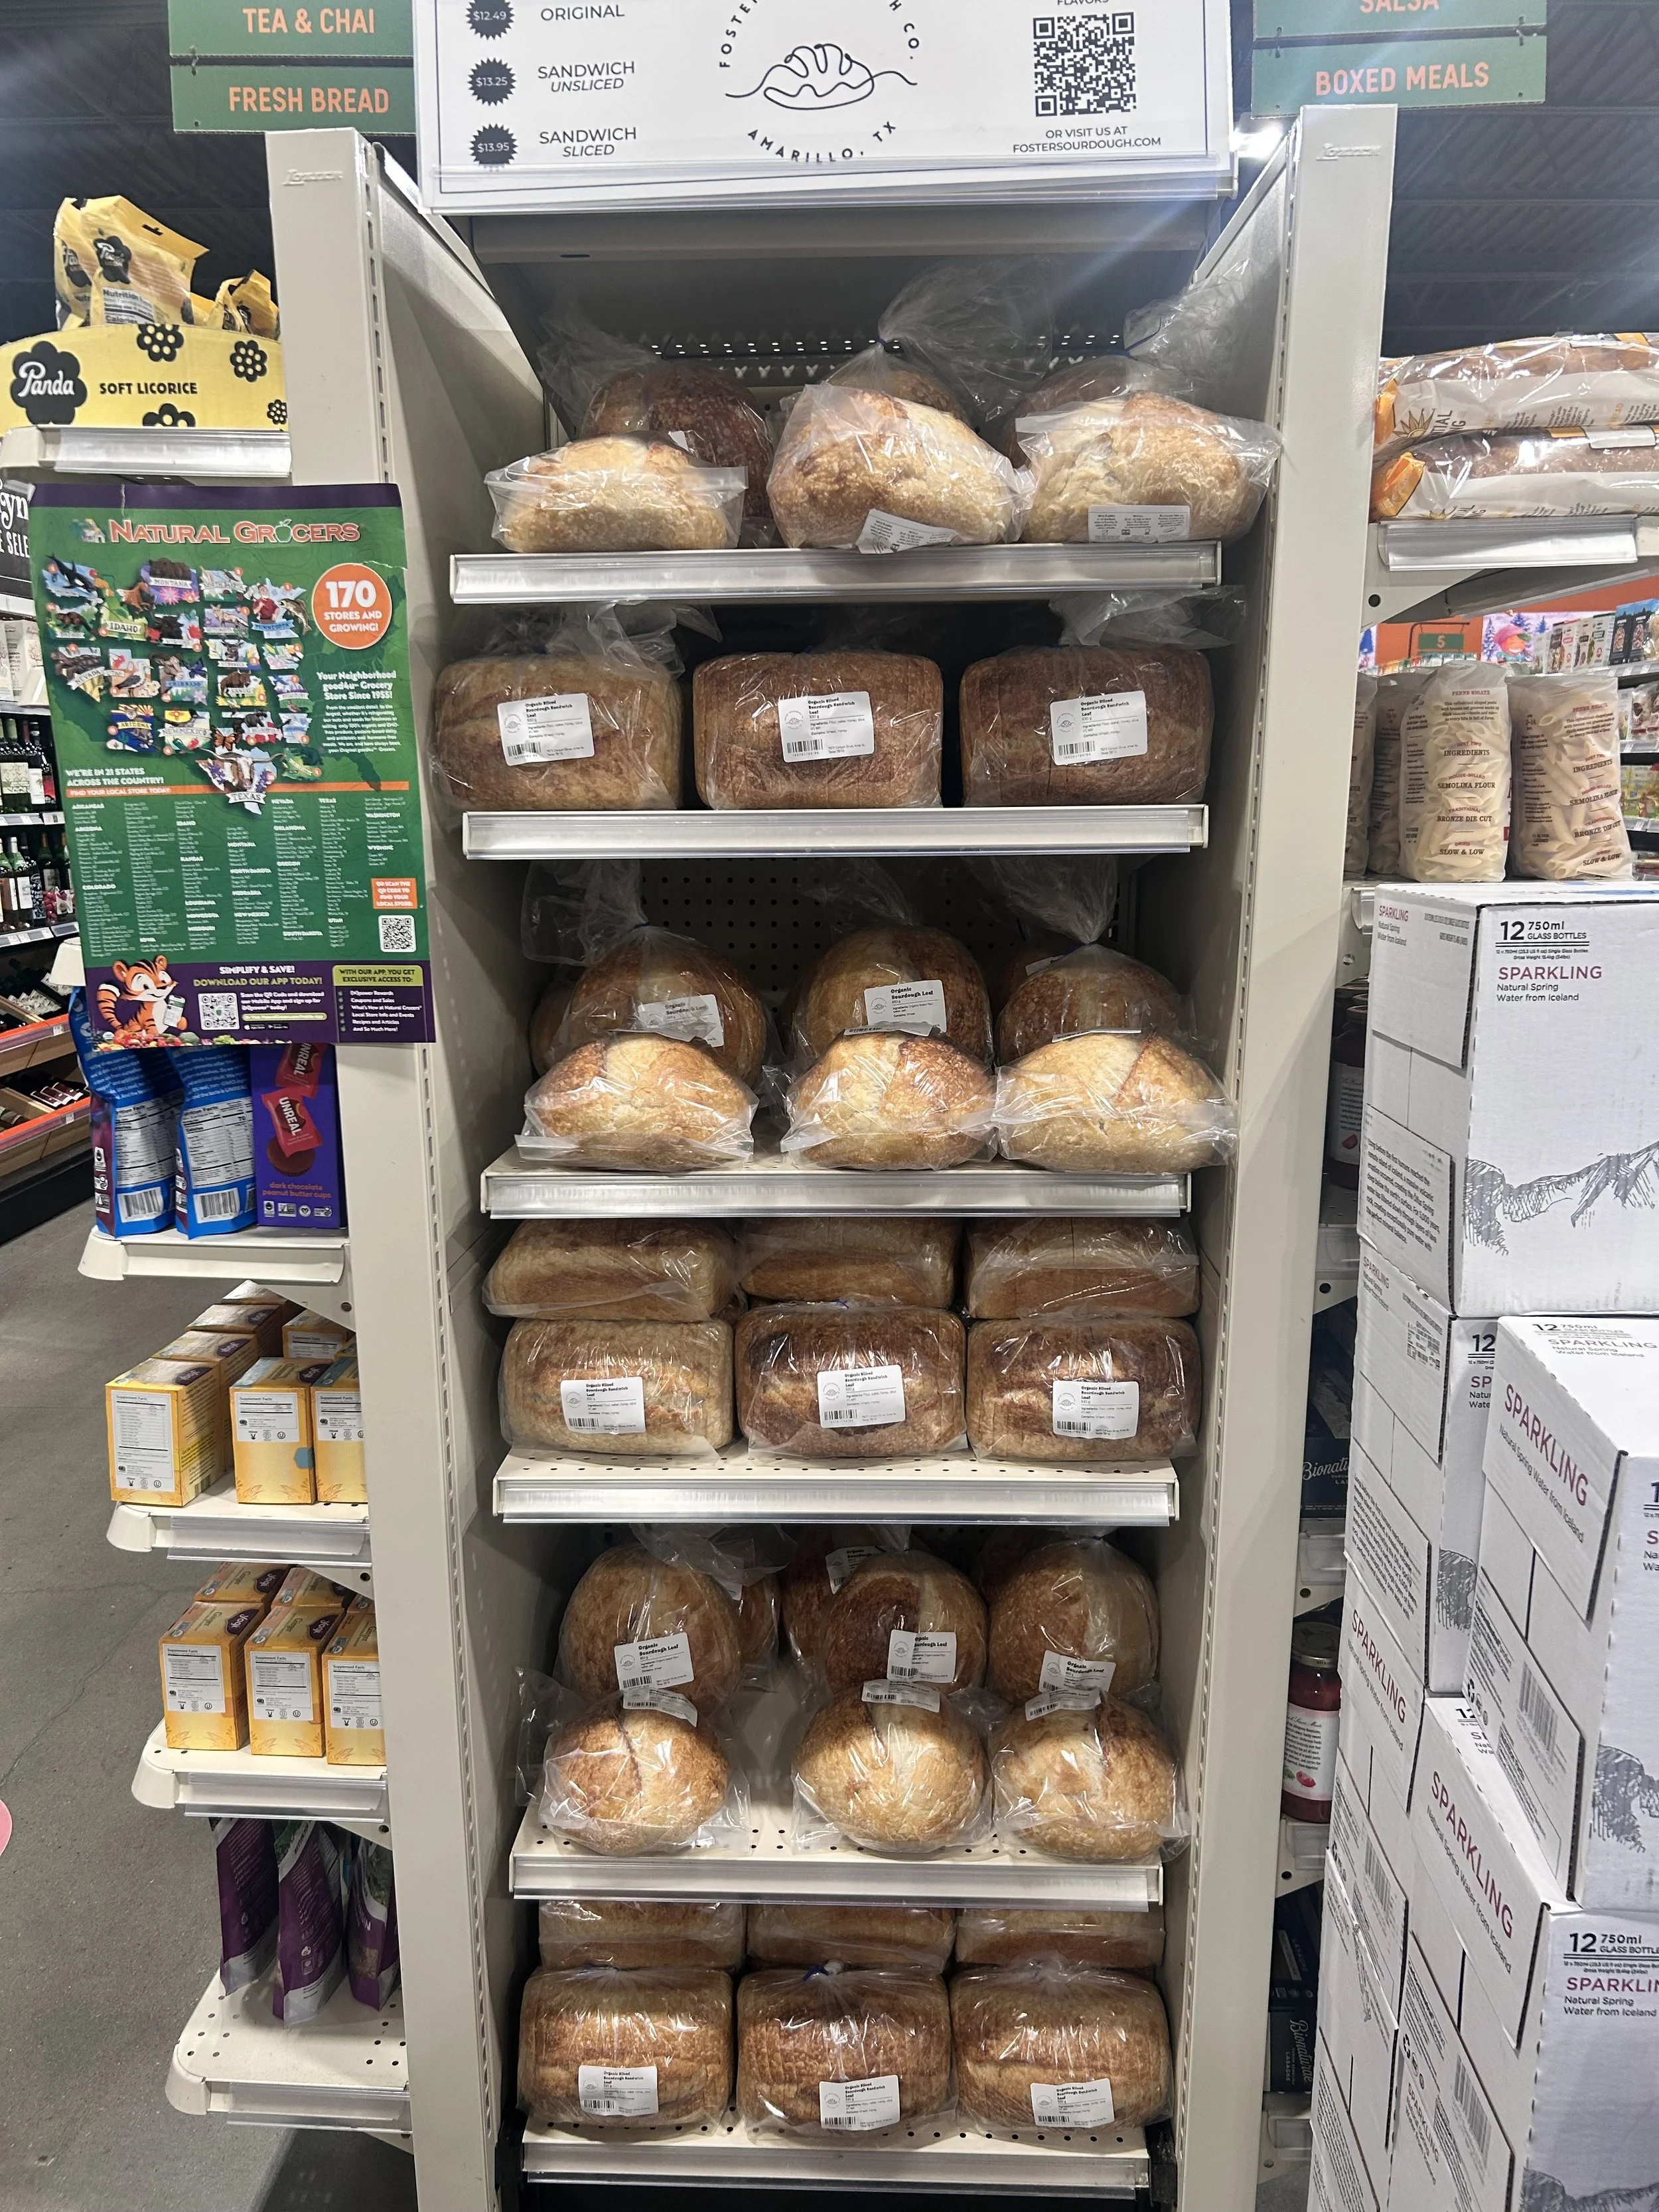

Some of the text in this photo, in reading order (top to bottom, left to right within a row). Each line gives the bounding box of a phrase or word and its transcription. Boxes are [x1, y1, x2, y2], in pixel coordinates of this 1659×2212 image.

[473, 10, 507, 21] $12.49
[540, 4, 624, 22] ORIGINAL
[243, 9, 375, 34] TEA & CHAI
[719, 0, 758, 67] FOSTE
[538, 61, 635, 80] SANDWICH
[475, 76, 508, 87] $13.25
[550, 77, 624, 93] UNSLICED
[1315, 62, 1489, 96] BOXED MEALS
[229, 87, 389, 113] FRESH BREAD
[539, 127, 637, 145] SANDWICH
[873, 121, 896, 143] TX
[1045, 126, 1127, 139] OR VISIT US AT
[477, 141, 510, 153] $13.95
[562, 144, 615, 158] SLICED
[1013, 137, 1161, 153] FOSTERSOURDOUGH.COM
[19, 361, 75, 396] Panda
[100, 382, 198, 394] SOFT LICORICE
[108, 519, 360, 544] NATURAL GROCERS
[154, 579, 188, 587] MONTANA
[326, 581, 377, 608] 170
[324, 611, 382, 621] STORES AND
[110, 625, 138, 633] IDAHO
[329, 623, 378, 632] GROWING!
[1437, 636, 1446, 649] 5
[74, 670, 101, 684] NEVADA
[338, 670, 396, 681] Neighborhood
[360, 682, 393, 690] Grocery
[1573, 759, 1613, 773] INGREDIENTS
[1569, 794, 1604, 806] SEMOLINA
[1575, 827, 1601, 838] BRONZE
[1583, 857, 1600, 866] SLOW
[1379, 905, 1409, 922] SPARKLING
[1500, 921, 1525, 940] 12
[1528, 921, 1565, 930] 750ml
[219, 966, 259, 974] SIMPLIFY
[1498, 966, 1602, 980] SPARKLING
[1530, 983, 1559, 992] Spring
[279, 1096, 303, 1136] UNREAL
[1473, 1334, 1496, 1352] 12
[1548, 1339, 1658, 1349] SPARKLING
[1504, 1384, 1588, 1507] SPARKLING
[1499, 1423, 1583, 1544] Natural Spring Water from Iceland
[639, 1647, 667, 1656] Sourdough
[1352, 1609, 1406, 1724] SPARKLING
[1431, 1771, 1514, 1939] SPARKLING
[1569, 1933, 1597, 1953] 12
[1601, 1934, 1642, 1945] 750ml
[1564, 1996, 1634, 2006] Natural Spring
[1563, 2006, 1657, 2017] Water from Iceland
